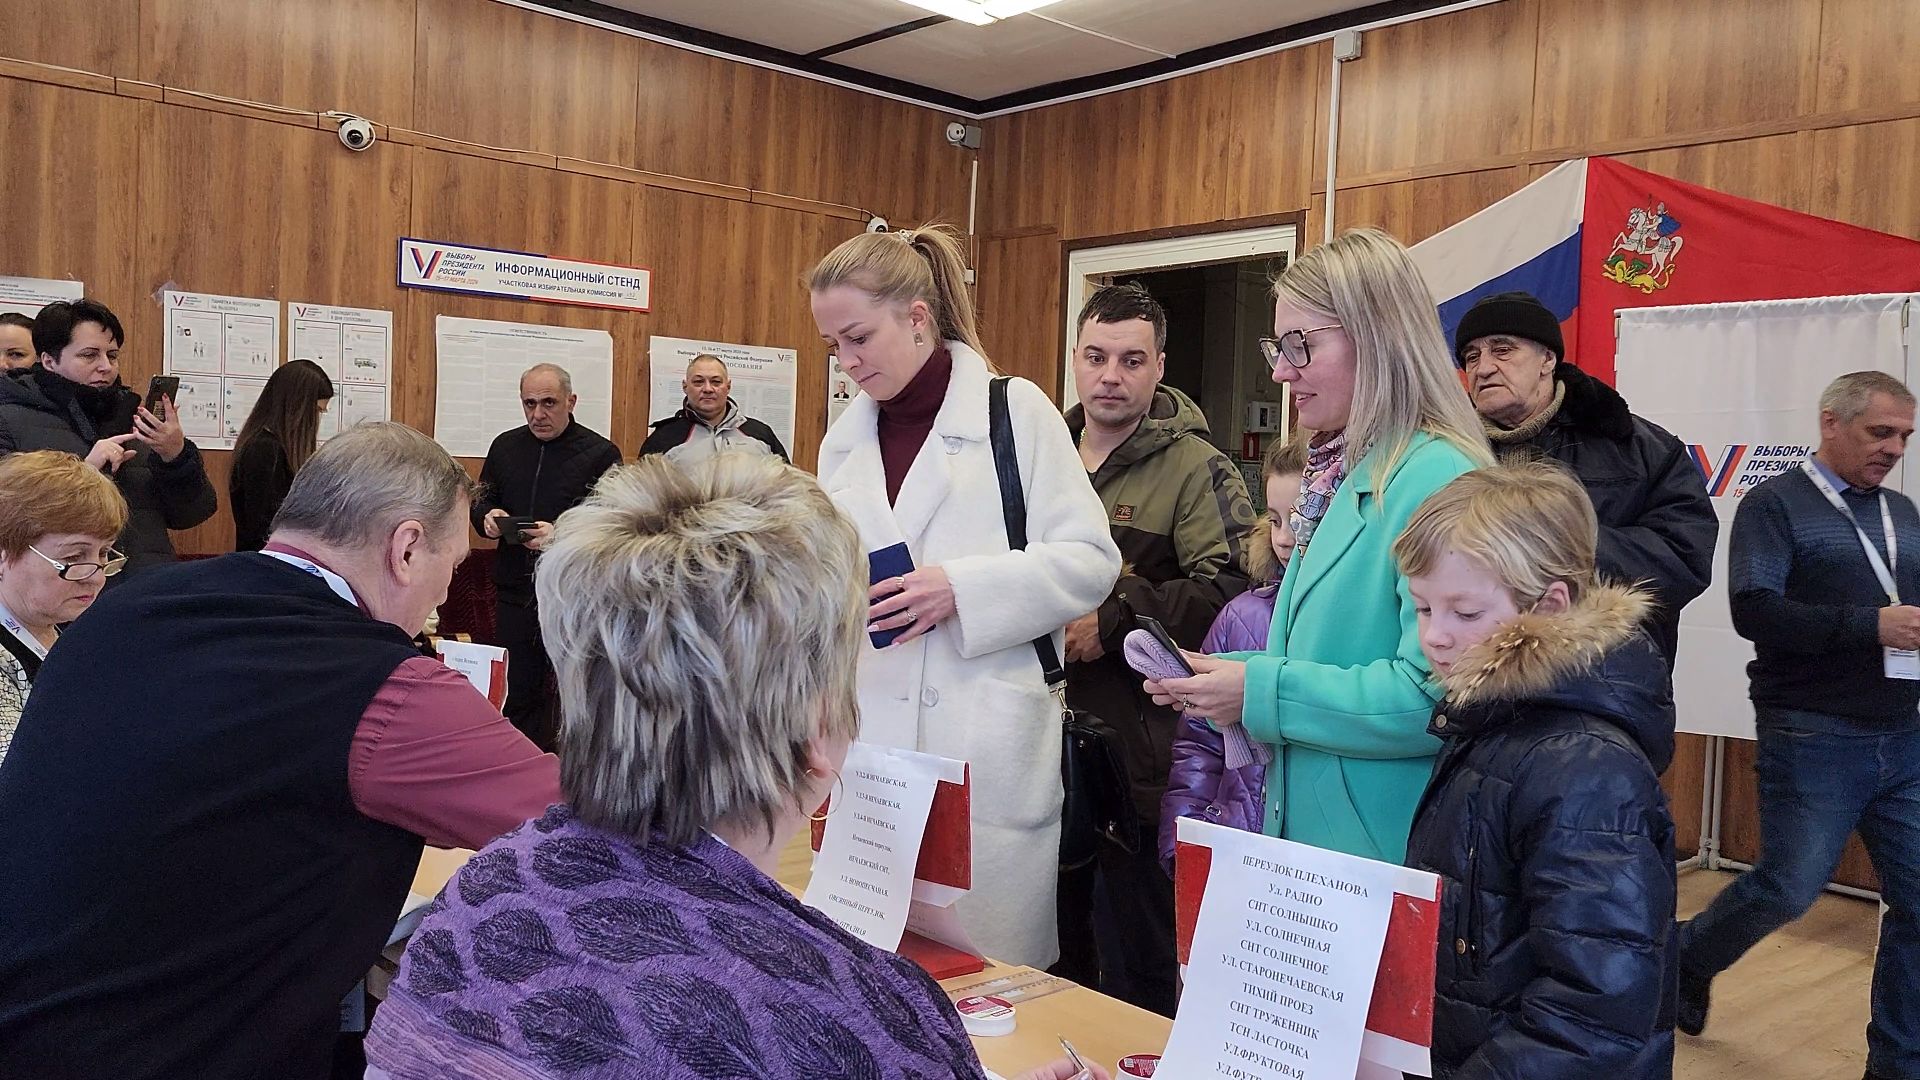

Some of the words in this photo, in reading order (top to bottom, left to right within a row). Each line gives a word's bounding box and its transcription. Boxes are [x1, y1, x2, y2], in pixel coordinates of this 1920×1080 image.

[438, 268, 466, 277] РОССИИ
[442, 260, 484, 271] ПРЕЗИДЕНТА
[446, 252, 476, 261] ВЫБОРЫ
[495, 262, 604, 284] ИНФОРМАЦИОННЫЙ
[607, 275, 641, 290] СТЕНД
[498, 280, 537, 290] УЧАСТКОВАЯ
[538, 283, 586, 294] ИЗБИРАТЕЛЬНАЯ
[586, 290, 617, 298] КОМИССИЯ
[724, 354, 749, 362] Российской
[750, 356, 773, 364] Федерации
[1753, 446, 1810, 457] ВЫБОРЫ
[1242, 856, 1294, 877] ПЕРЕУЛОК
[1294, 869, 1369, 898] ПЛЕХАНОВА
[1268, 883, 1282, 896] Ул.
[1285, 888, 1323, 907] РАДИО
[1248, 899, 1268, 912] СНТ
[1270, 906, 1338, 933] СОЛНЫШКО
[1246, 920, 1262, 932] УЛ.
[1264, 925, 1332, 954] СОЛНЕЧНАЯ
[1240, 939, 1262, 954] СНТ
[1263, 946, 1329, 976] СОЛНЕЧНОЕ
[1222, 954, 1237, 968] УЛ.
[1239, 960, 1344, 1002] СТАРОНЕЧАЕВСКАЯ
[1242, 982, 1277, 1003] ТИХИЙ
[1280, 995, 1314, 1015] ПРОЕЗ
[1230, 1000, 1251, 1015] СНТ
[1252, 1007, 1320, 1040] ТРУЖЕННИК
[1230, 1022, 1250, 1038] ТСН
[1251, 1031, 1310, 1060] ЛАСТОЧКА
[1224, 1042, 1305, 1080] УЛ.ФРУКТОВАЯ
